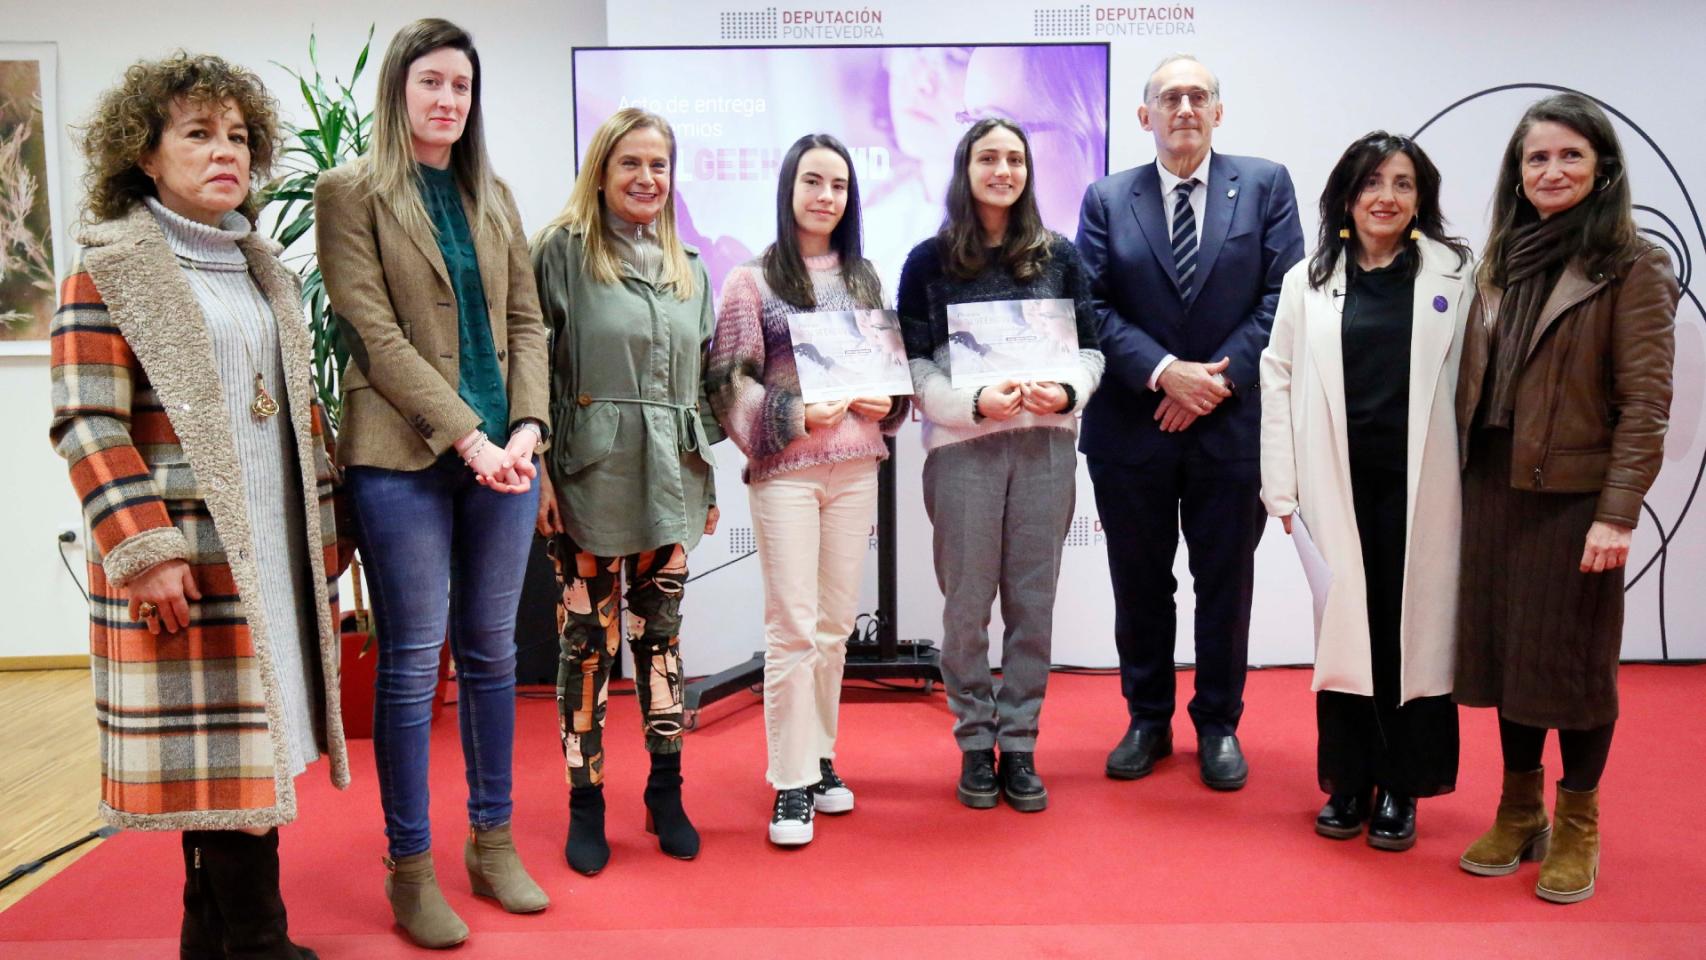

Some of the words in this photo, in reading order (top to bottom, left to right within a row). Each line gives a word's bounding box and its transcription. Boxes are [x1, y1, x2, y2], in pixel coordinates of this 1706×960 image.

[783, 7, 882, 24] DEPUTACIÓN
[1096, 4, 1194, 21] DEPUTACIÓN
[783, 26, 883, 39] PONTEVEDRA
[1096, 23, 1195, 36] PONTEVEDRA
[666, 96, 688, 112] de
[695, 96, 766, 117] entrega
